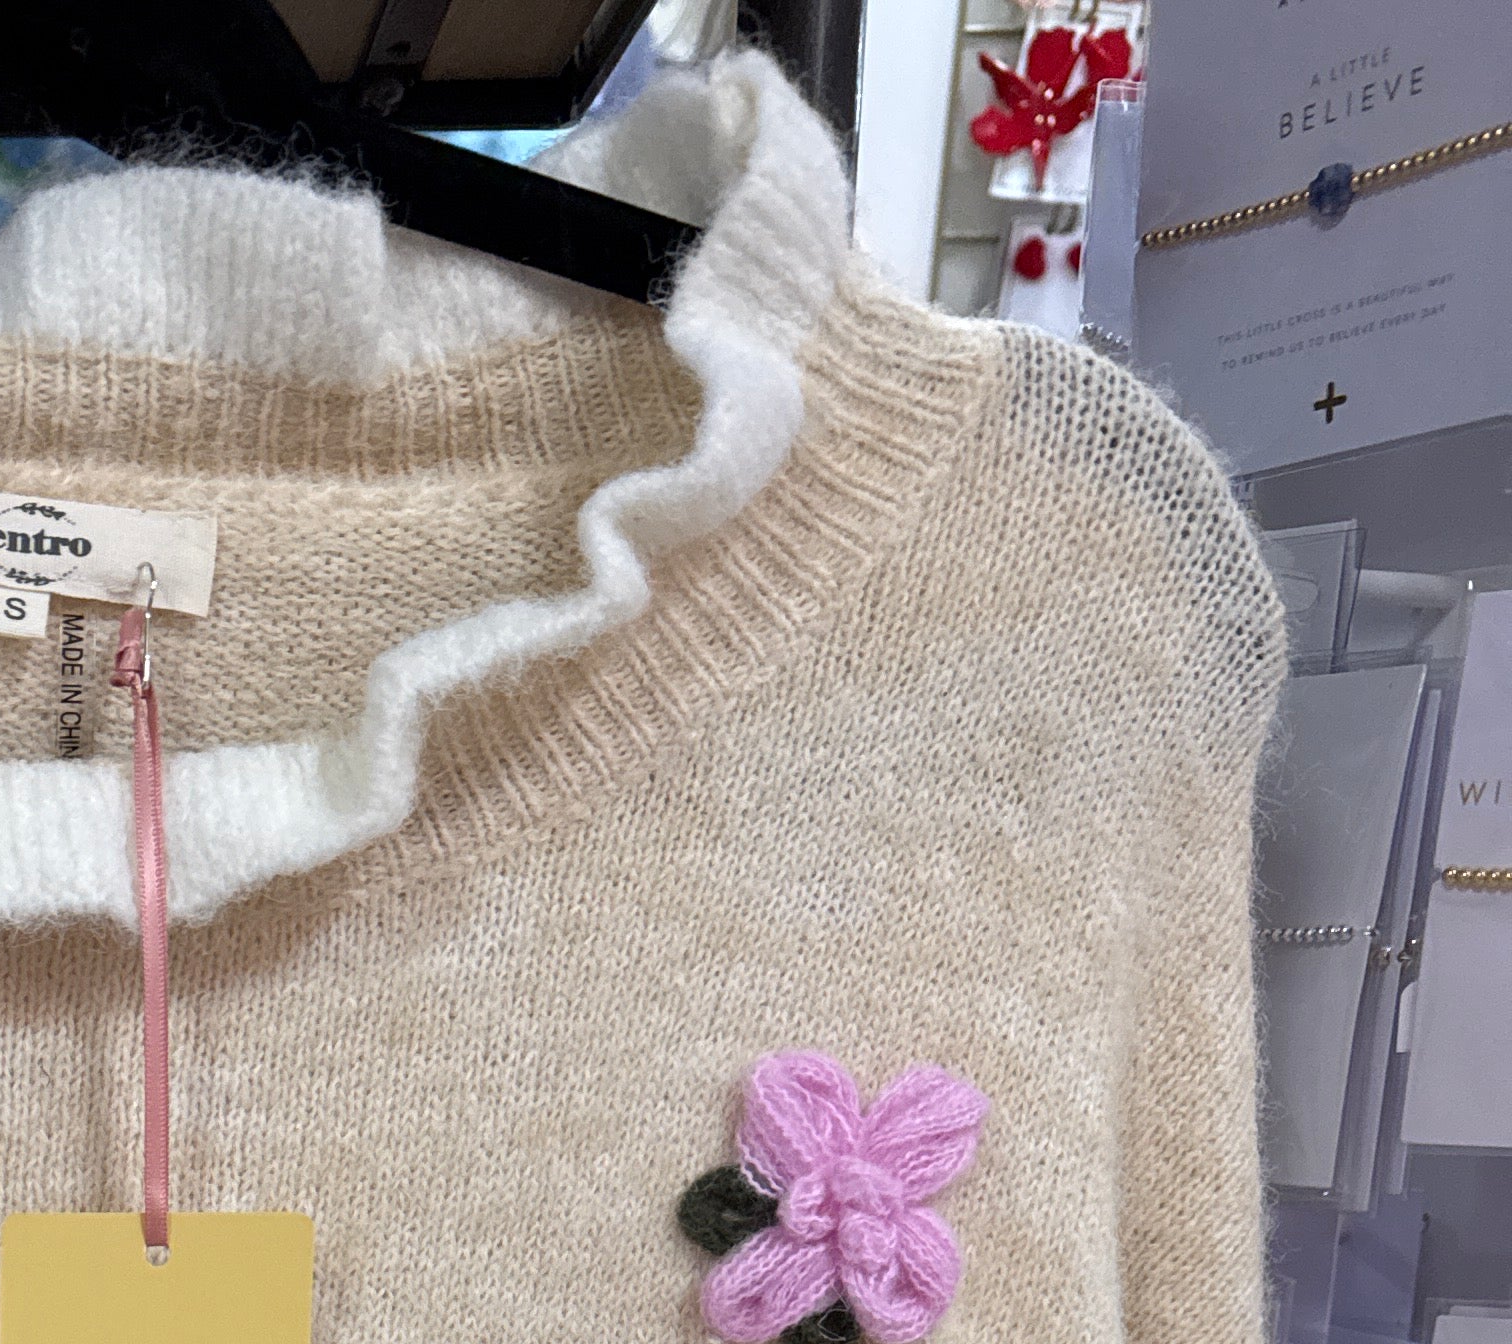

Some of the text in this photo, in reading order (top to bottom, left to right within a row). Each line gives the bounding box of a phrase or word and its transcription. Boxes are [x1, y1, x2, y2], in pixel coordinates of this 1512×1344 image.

[1310, 47, 1391, 89] A LITTLE
[1279, 66, 1425, 140] BELIEVE
[1221, 358, 1237, 371] TO
[3, 597, 27, 621] S
[58, 613, 85, 759] MADE IN CHIN
